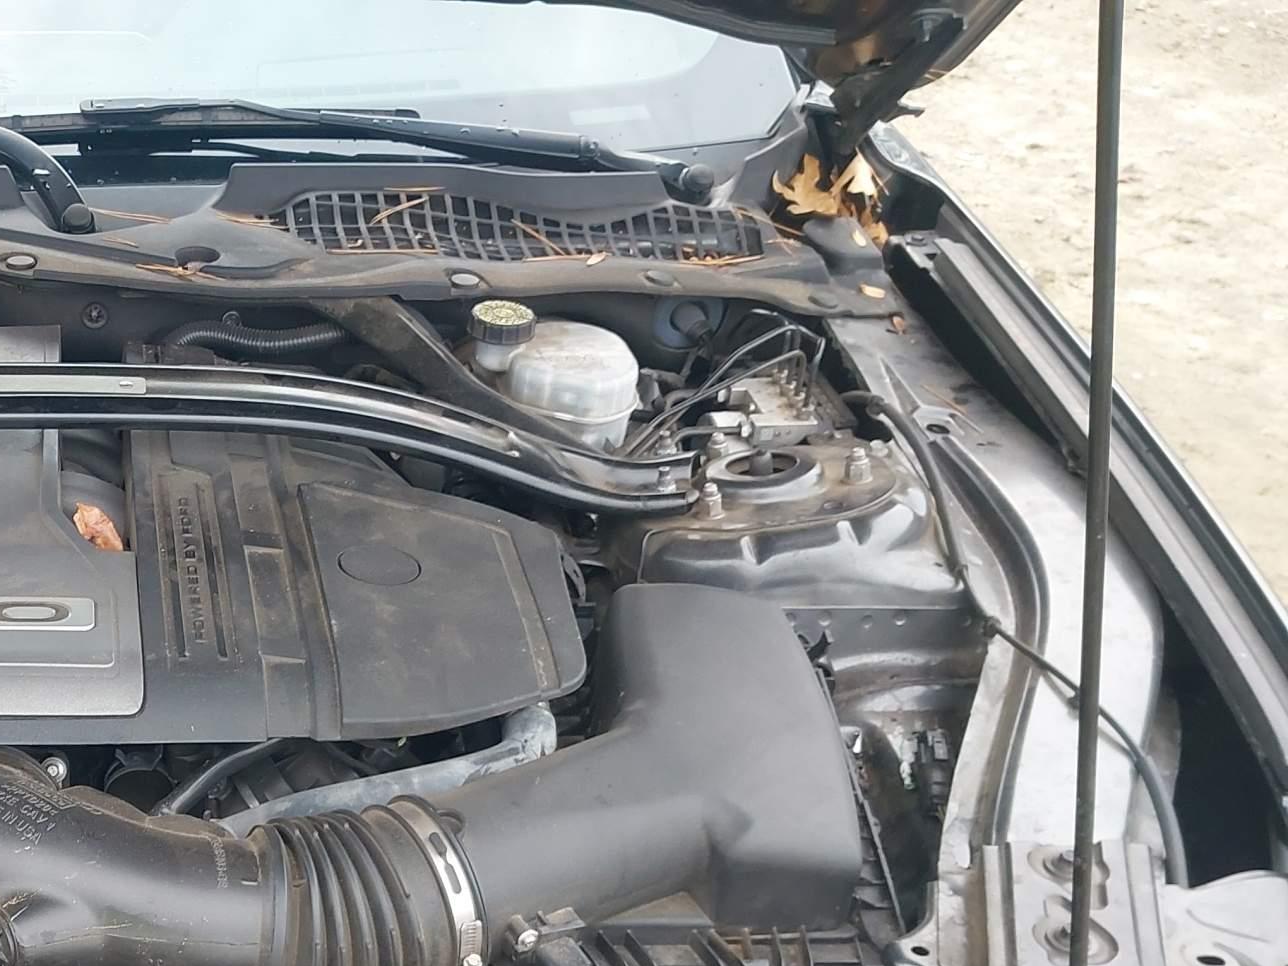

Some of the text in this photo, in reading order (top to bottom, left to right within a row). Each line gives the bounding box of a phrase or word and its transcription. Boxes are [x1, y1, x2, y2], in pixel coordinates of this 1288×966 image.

[183, 540, 198, 561] BY
[1, 809, 19, 826] IN
[16, 819, 43, 845] USA
